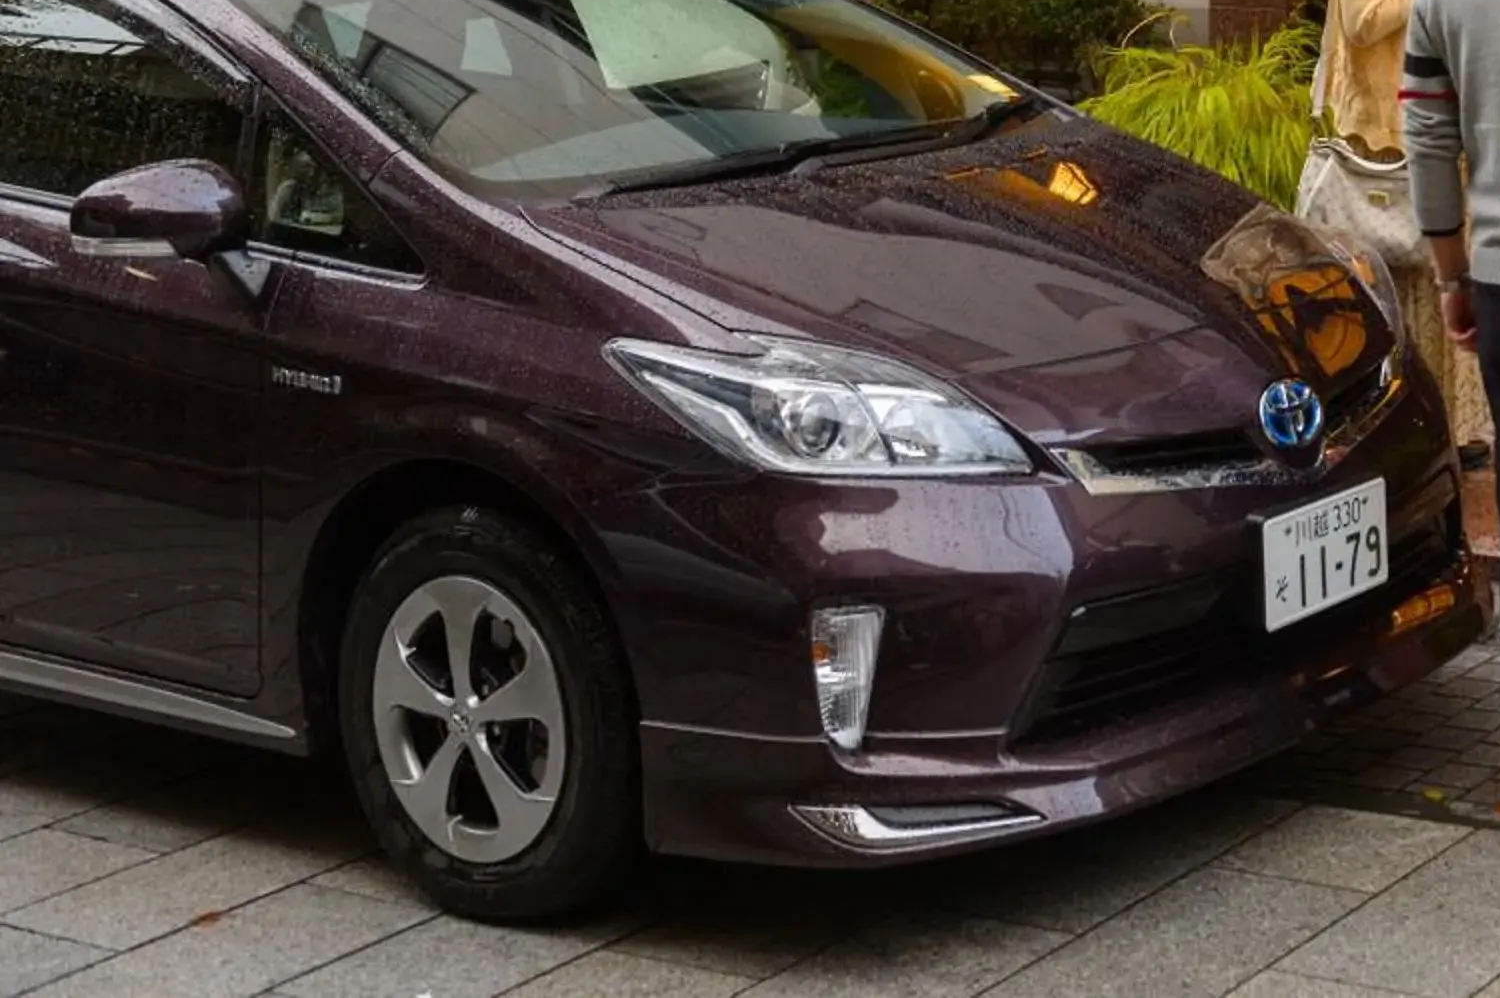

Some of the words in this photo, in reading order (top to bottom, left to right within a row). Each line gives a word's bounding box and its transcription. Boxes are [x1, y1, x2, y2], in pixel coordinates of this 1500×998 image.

[1295, 509, 1330, 547] 川越
[1333, 497, 1361, 533] 330
[1299, 525, 1381, 608] 11-79
